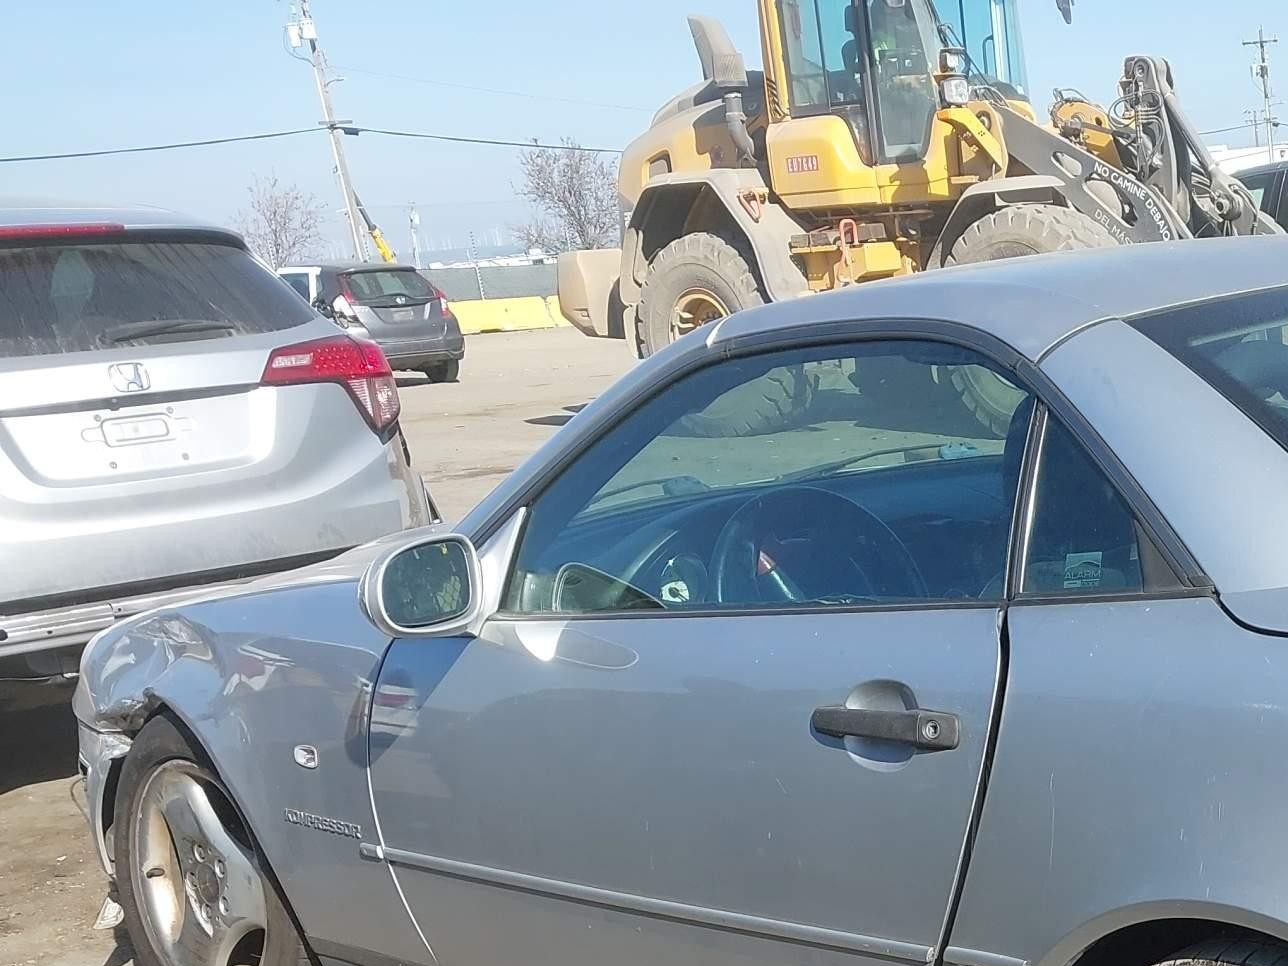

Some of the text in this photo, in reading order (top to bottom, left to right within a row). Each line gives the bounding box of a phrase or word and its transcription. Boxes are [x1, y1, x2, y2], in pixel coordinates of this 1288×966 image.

[1094, 161, 1171, 242] NO CAMINE DEBAJO
[1094, 208, 1111, 228] DEL
[1064, 569, 1101, 580] ALARM
